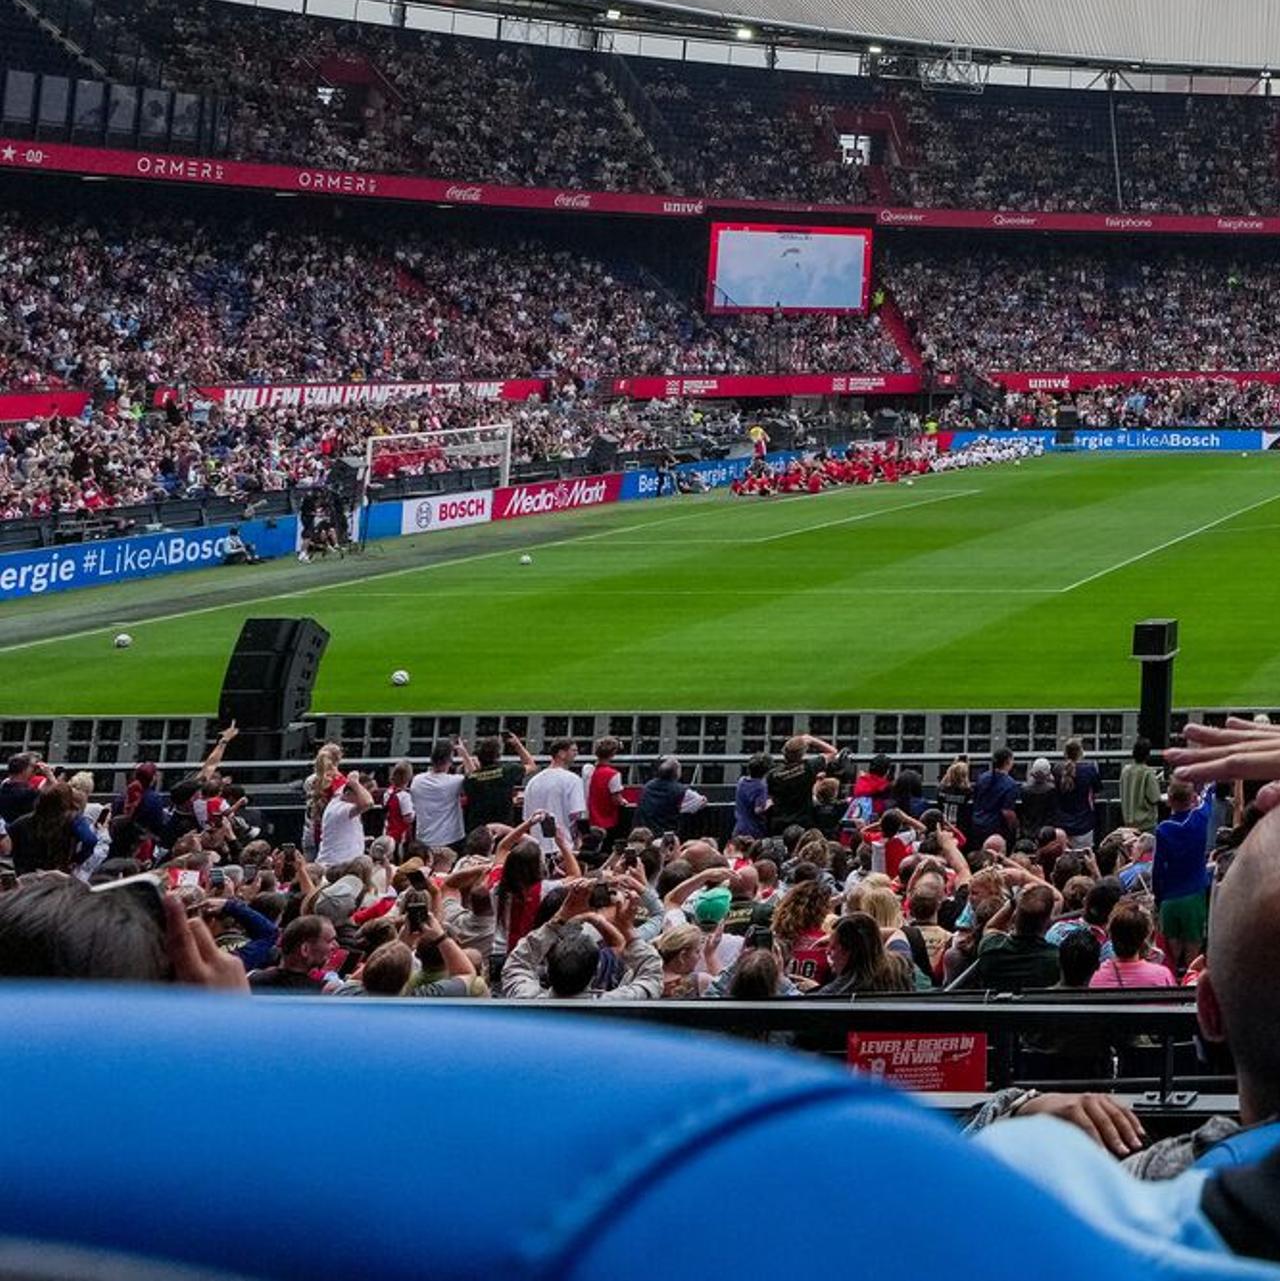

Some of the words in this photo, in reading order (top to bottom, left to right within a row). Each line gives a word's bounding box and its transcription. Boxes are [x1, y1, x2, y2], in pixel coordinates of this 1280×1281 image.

[663, 200, 704, 214] univé
[1028, 376, 1070, 389] univé
[1117, 433, 1220, 447] #LikeABosch
[438, 497, 485, 521] BOSCH
[83, 537, 226, 576] #LikeABosc
[860, 1040, 901, 1055] LEVER
[902, 1040, 916, 1053] JE
[917, 1038, 958, 1052] BEKER
[960, 1036, 975, 1050] IN
[892, 1053, 910, 1065] EN
